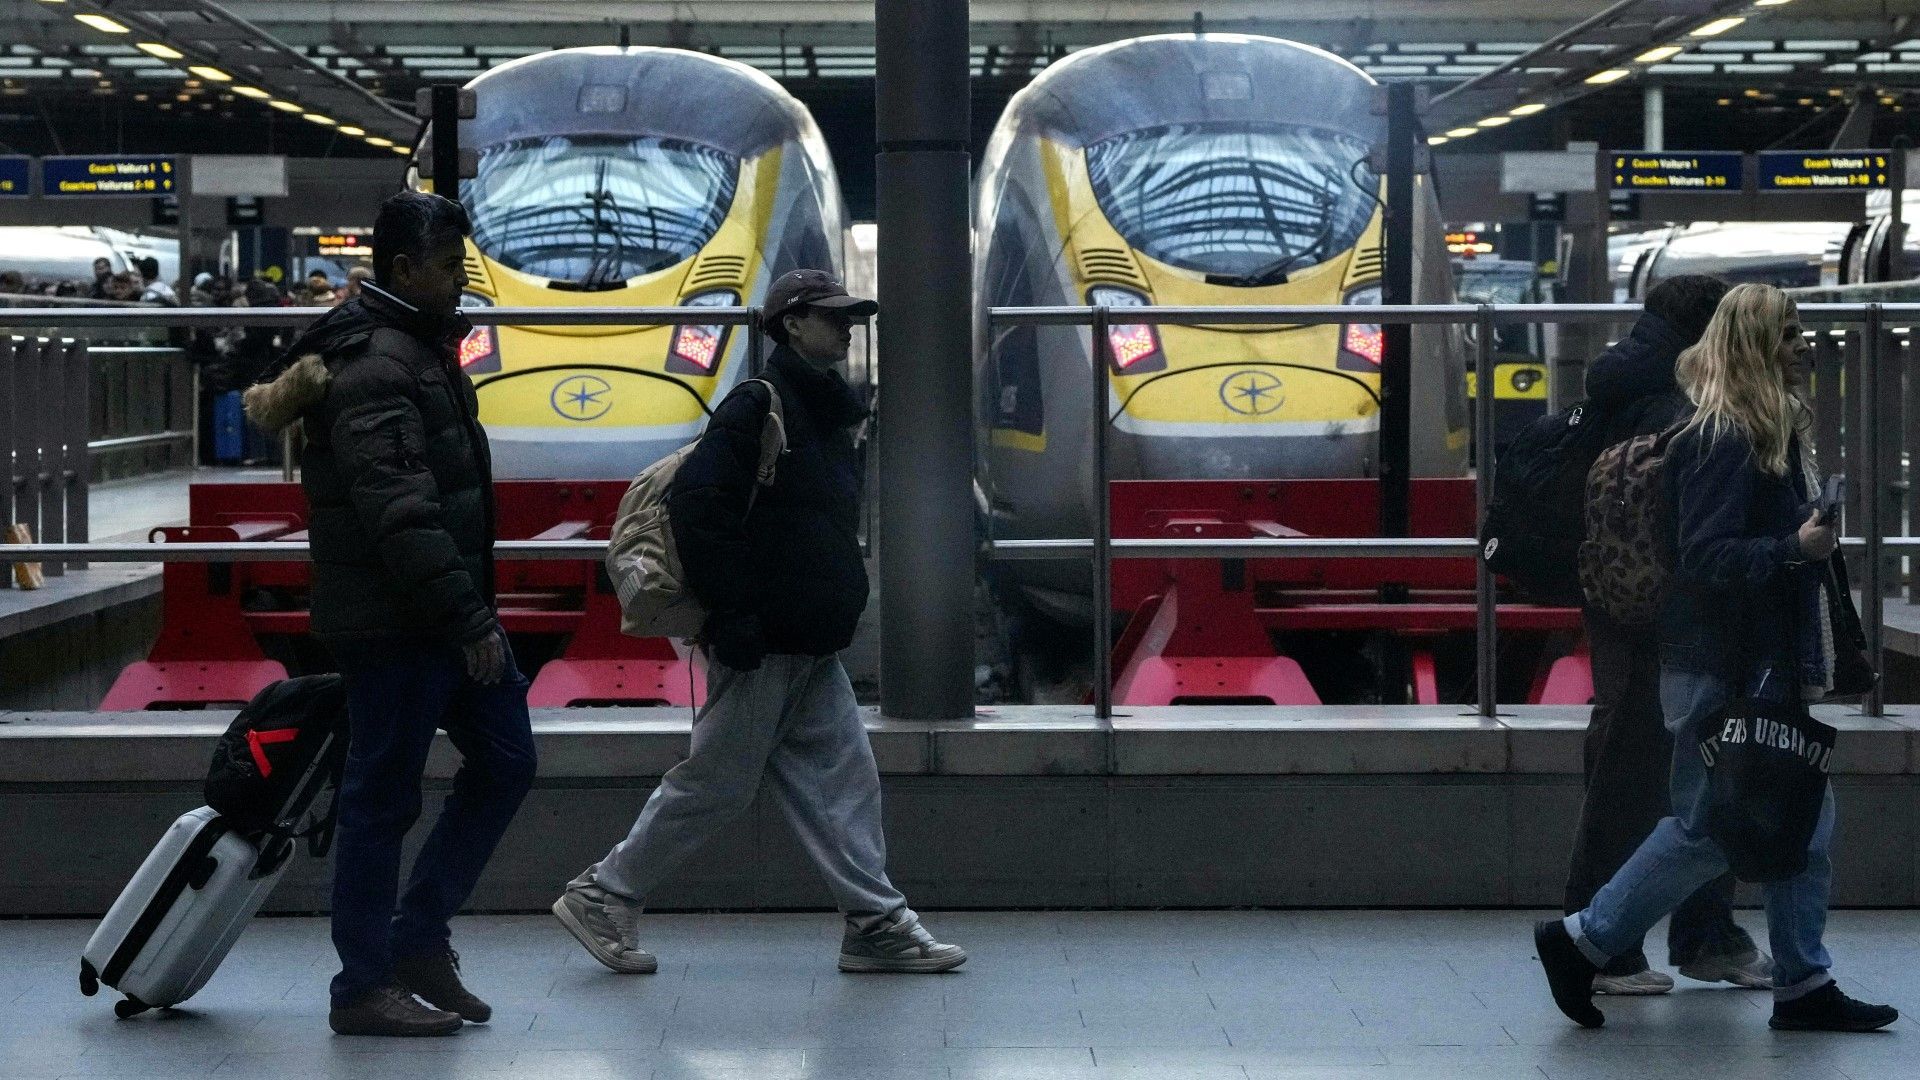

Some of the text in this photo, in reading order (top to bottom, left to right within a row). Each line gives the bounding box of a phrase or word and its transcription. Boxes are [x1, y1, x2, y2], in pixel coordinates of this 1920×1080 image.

[1632, 159, 1698, 169] Coach Voiture 1
[1803, 157, 1870, 169] Coach Voiture 1
[1632, 175, 1668, 186] Coaches
[1668, 175, 1705, 186] Voitures
[1774, 175, 1811, 186] Coaches
[1811, 174, 1848, 186] Voitures
